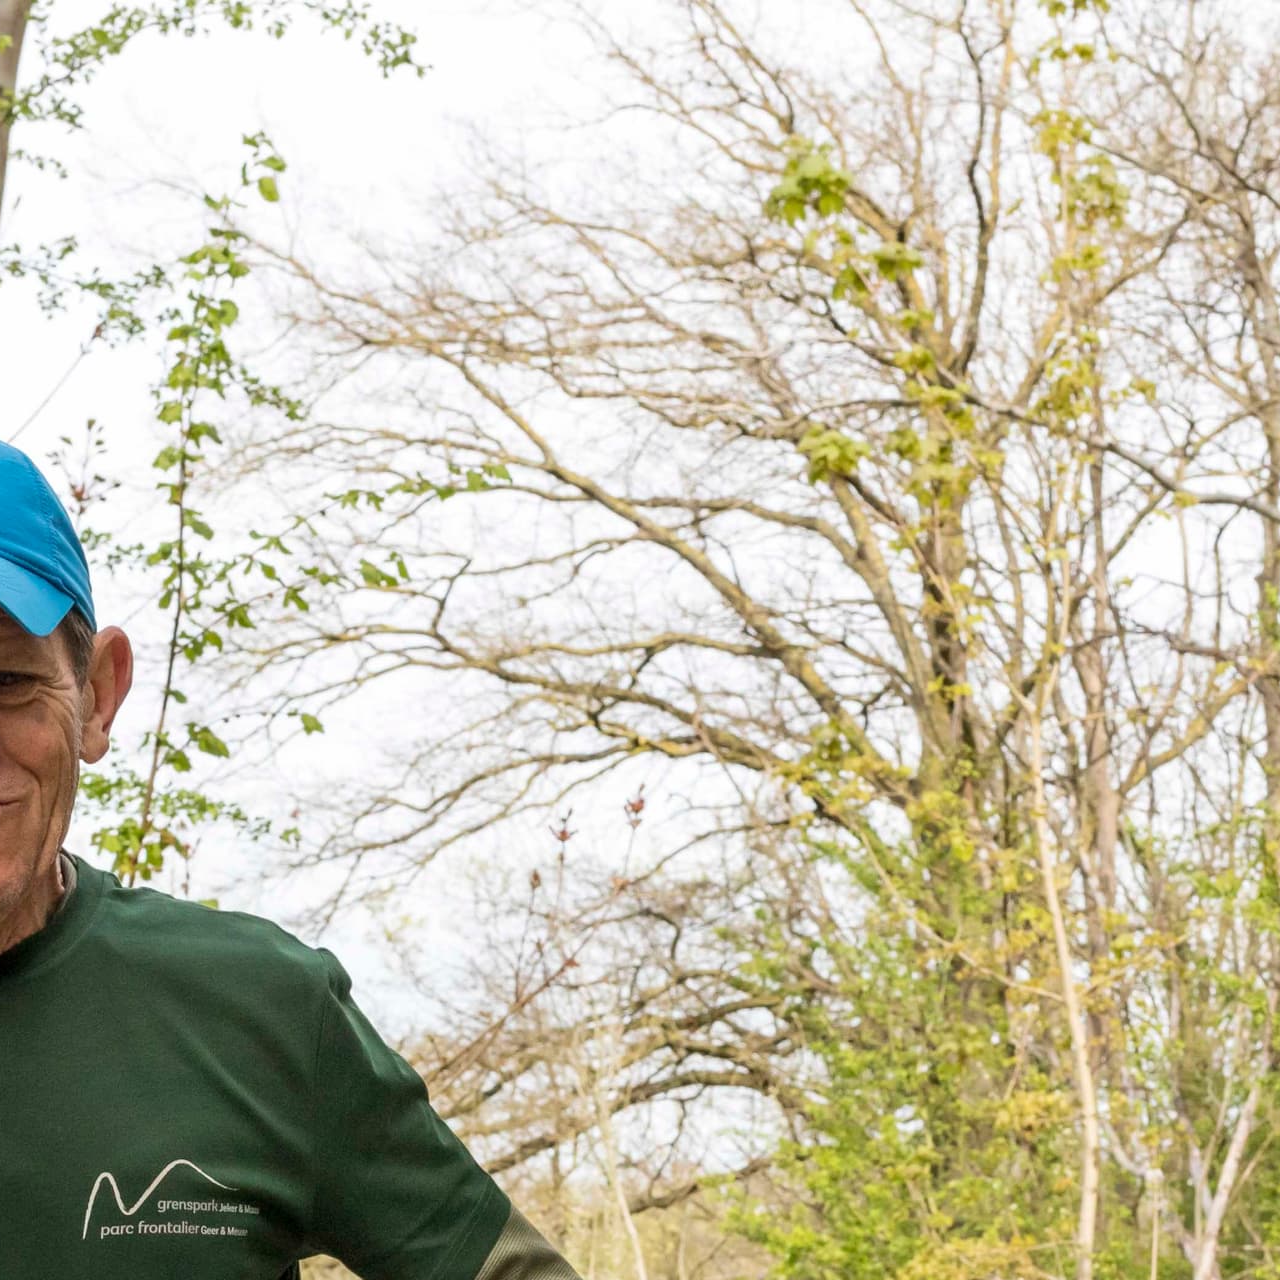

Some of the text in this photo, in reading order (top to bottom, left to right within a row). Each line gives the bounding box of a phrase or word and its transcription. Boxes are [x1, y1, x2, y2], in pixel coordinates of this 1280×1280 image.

[157, 1199, 218, 1214] grenspark
[100, 1223, 134, 1239] parc
[138, 1220, 200, 1235] frontalier
